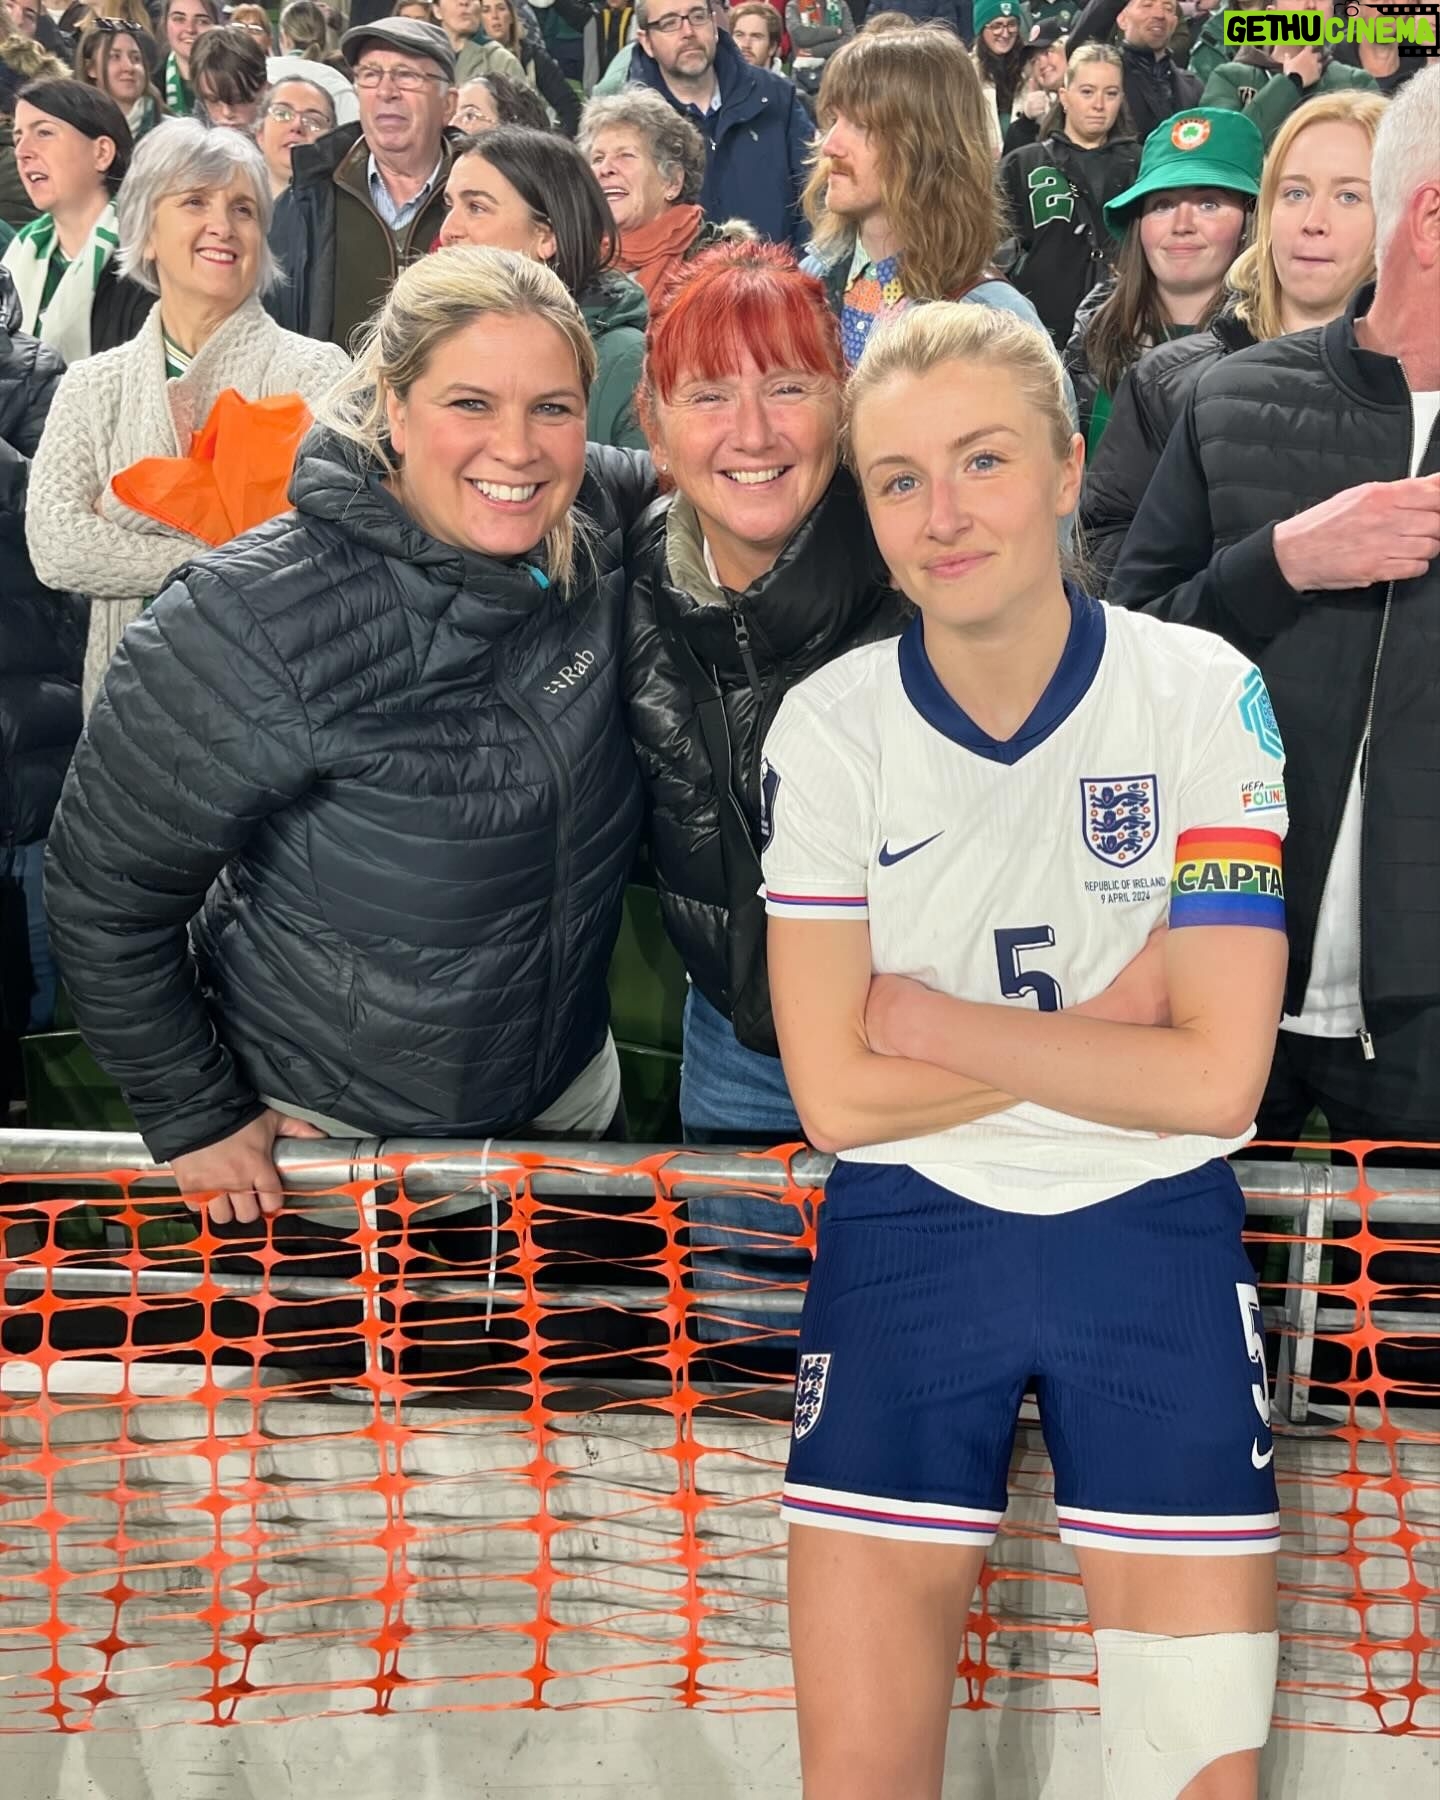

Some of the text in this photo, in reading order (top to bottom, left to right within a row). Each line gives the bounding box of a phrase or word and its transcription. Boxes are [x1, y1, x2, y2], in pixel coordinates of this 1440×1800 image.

[559, 650, 595, 686] Rab
[1241, 780, 1264, 792] UEFA
[1084, 876, 1167, 892] REPUBLIC OF IRELAND
[1100, 890, 1151, 904] 9 APRIL 2024
[994, 924, 1064, 1012] 5
